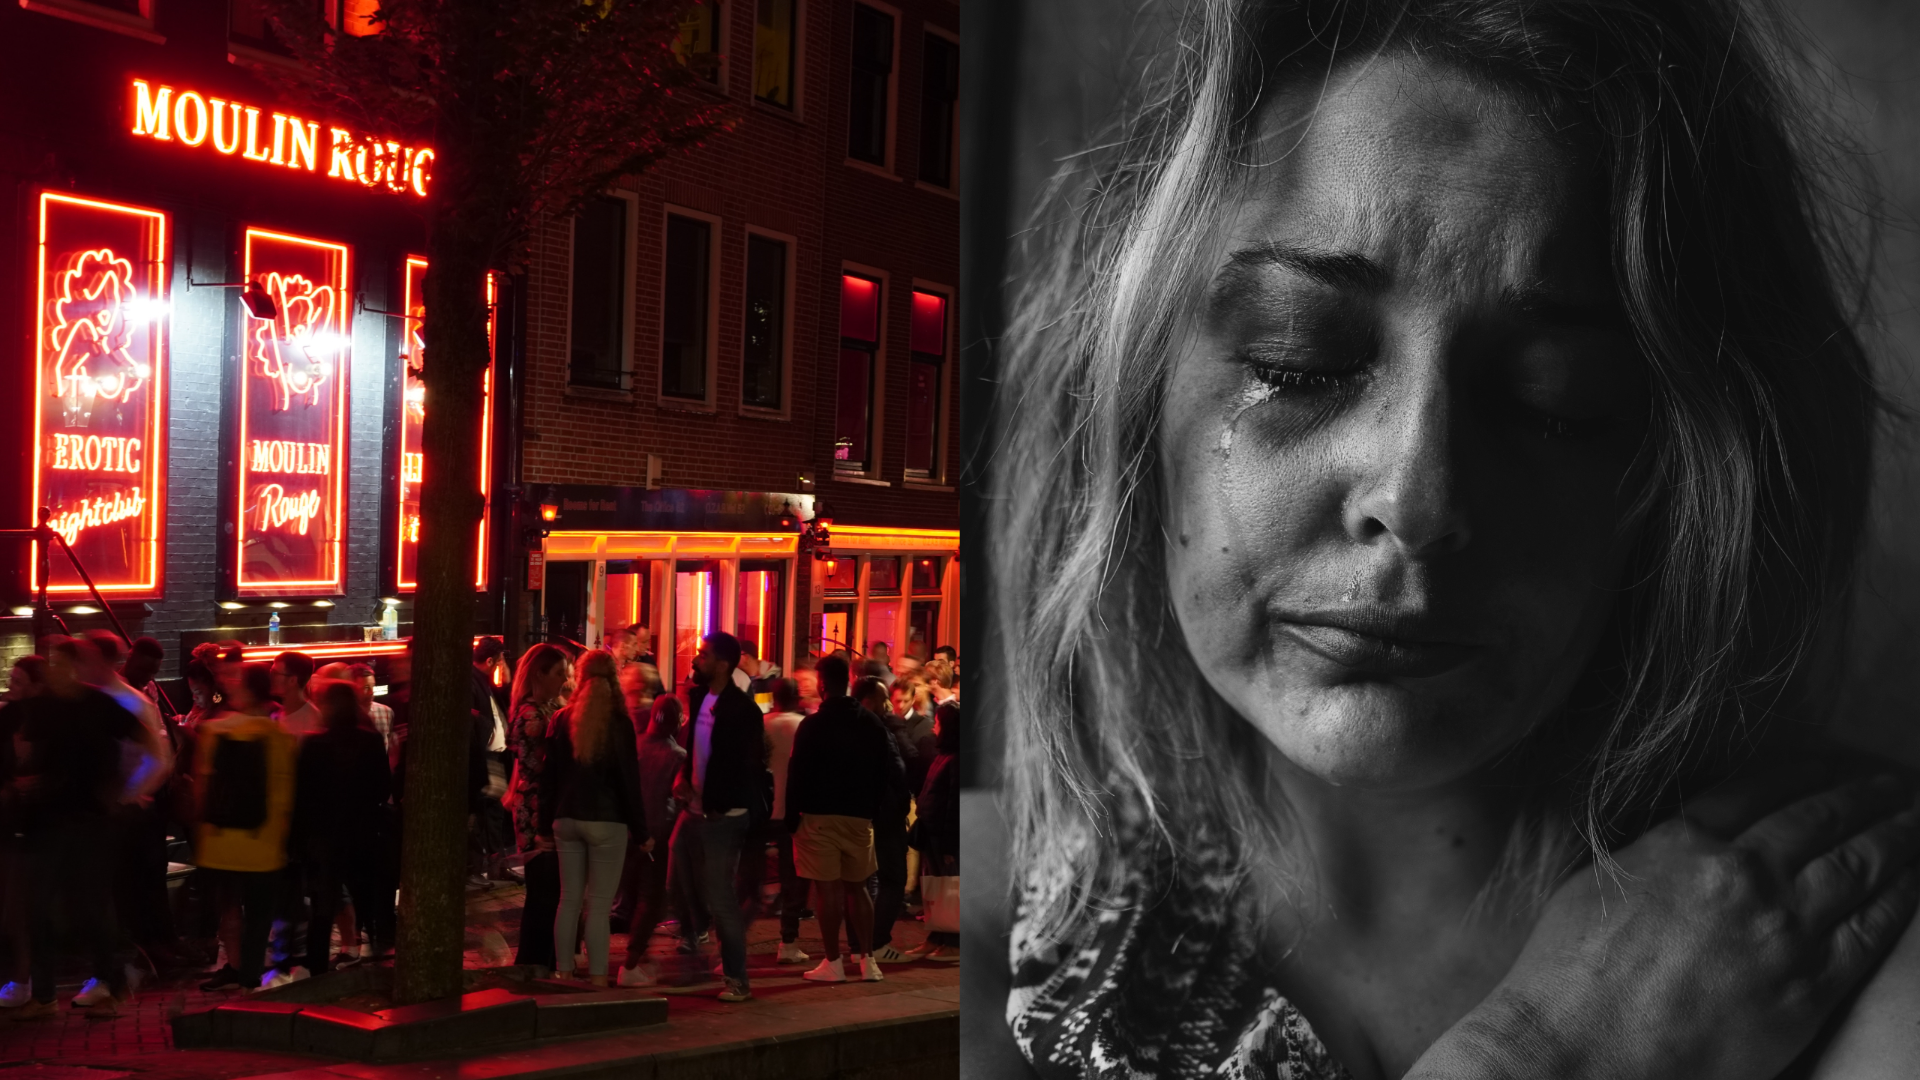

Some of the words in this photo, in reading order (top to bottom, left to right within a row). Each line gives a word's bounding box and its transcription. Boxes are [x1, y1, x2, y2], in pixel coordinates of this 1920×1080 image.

[132, 78, 319, 172] MOULIN
[328, 127, 435, 197] ROUG
[52, 432, 142, 474] EROTIC
[251, 439, 331, 475] MOULIN
[45, 486, 147, 547] nightclub
[260, 483, 321, 536] Rouge
[563, 497, 588, 511] Rooms
[589, 498, 600, 511] for
[600, 498, 617, 512] Rent
[641, 500, 653, 513] The
[599, 565, 604, 578] 9
